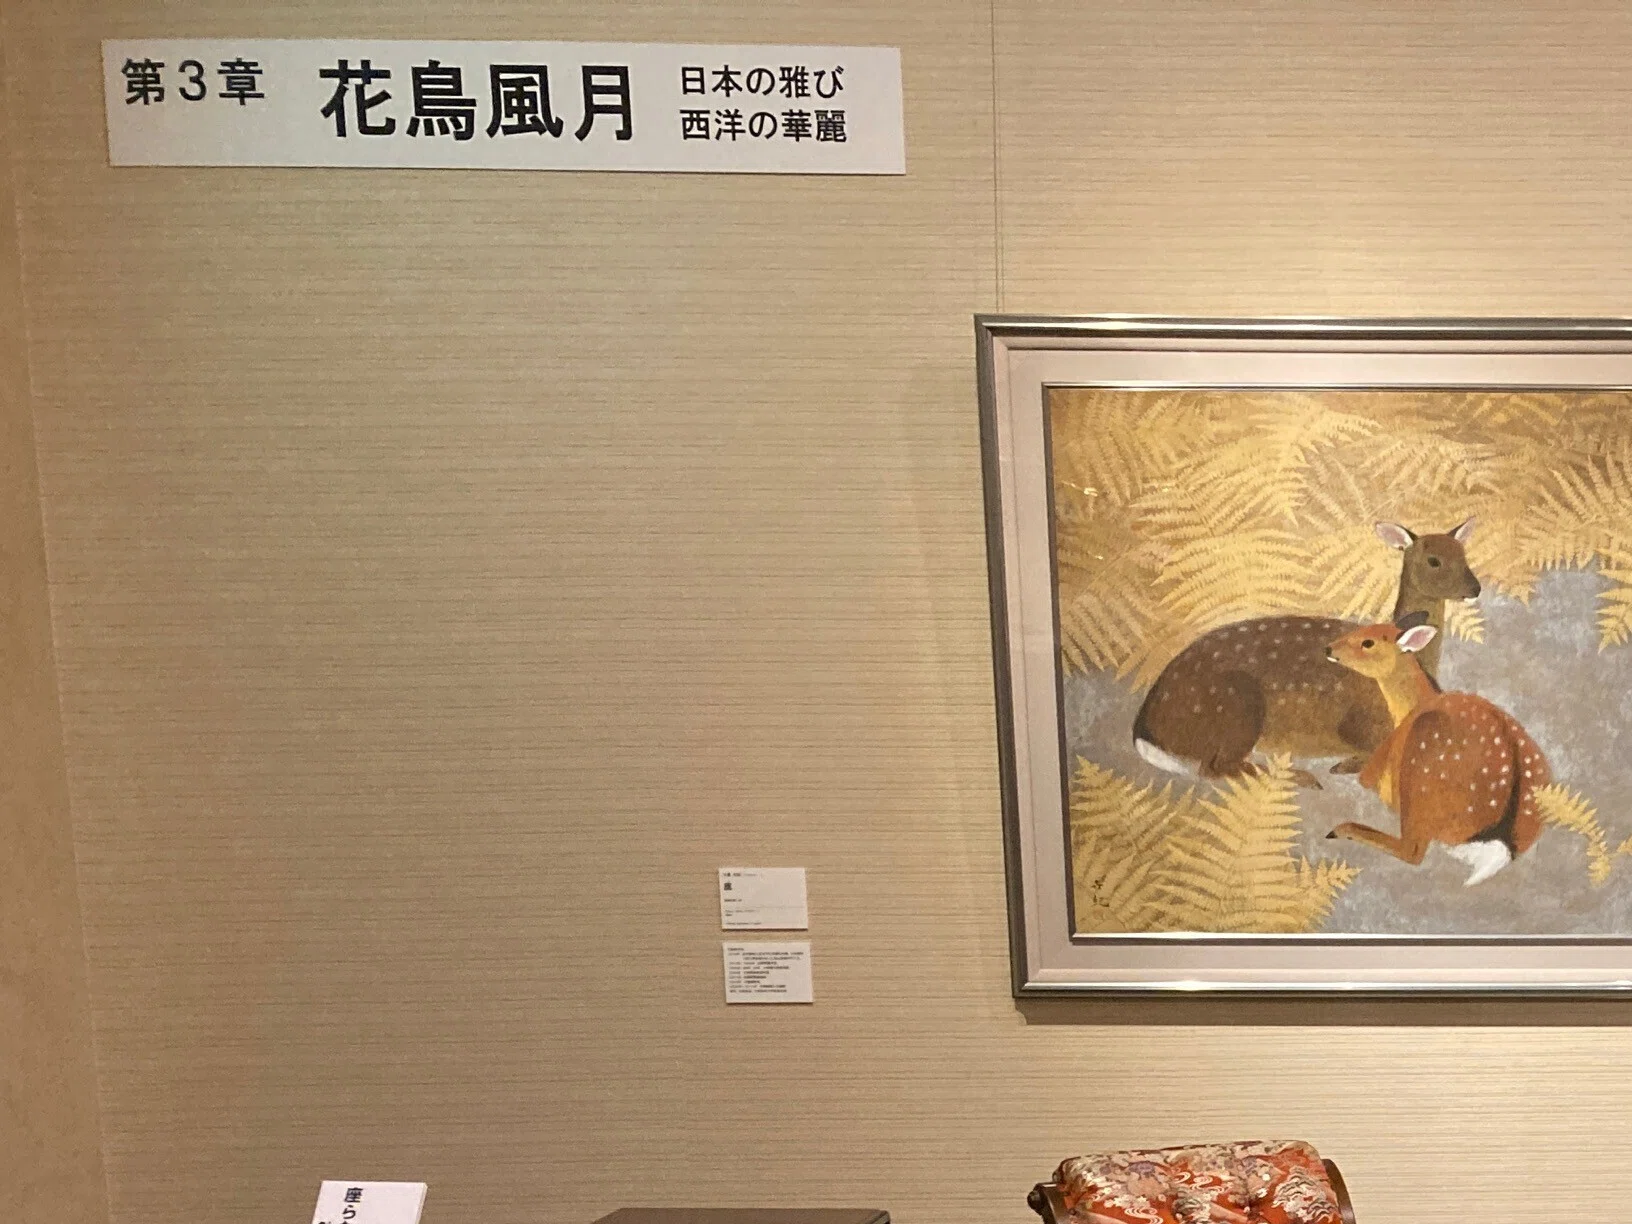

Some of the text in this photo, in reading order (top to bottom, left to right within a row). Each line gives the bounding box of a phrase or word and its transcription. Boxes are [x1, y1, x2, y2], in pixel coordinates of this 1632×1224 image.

[681, 64, 845, 99] 日本の雅び
[120, 57, 634, 143] 第3章 花鳥風月
[679, 109, 847, 142] 西洋の華麗
